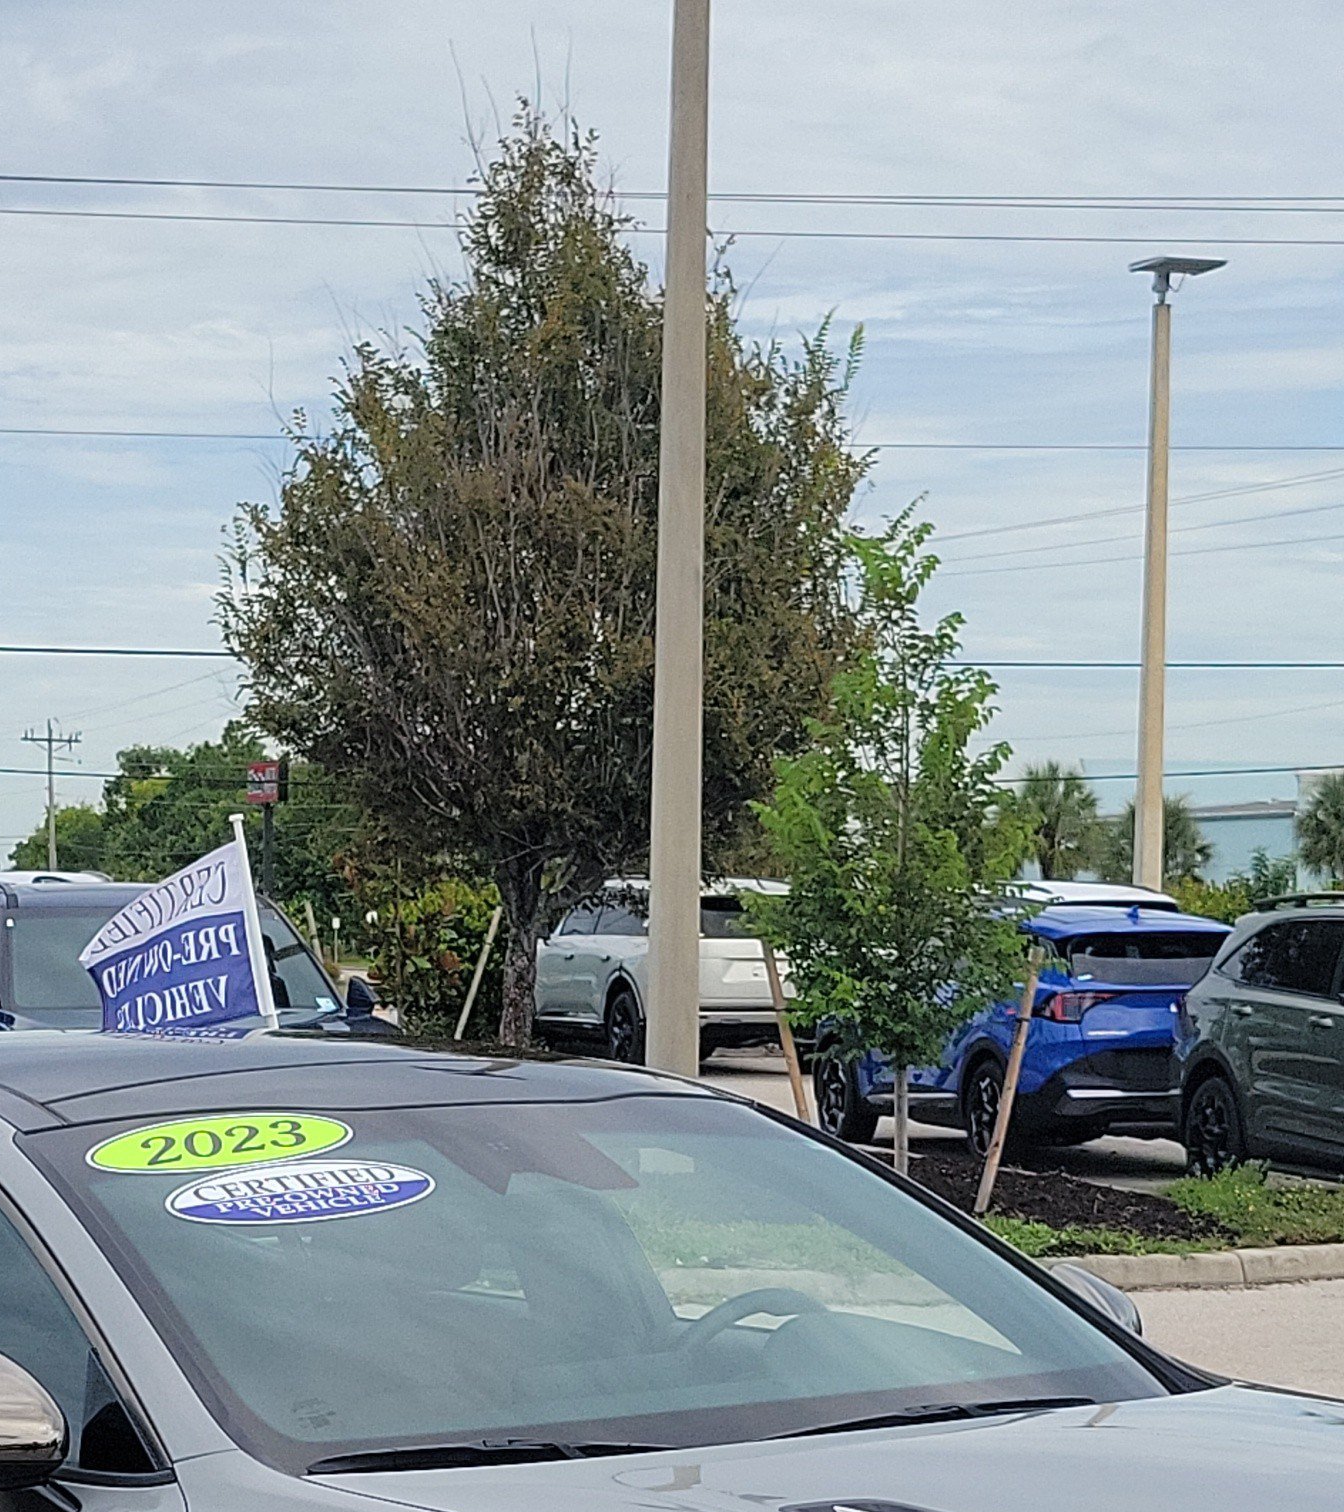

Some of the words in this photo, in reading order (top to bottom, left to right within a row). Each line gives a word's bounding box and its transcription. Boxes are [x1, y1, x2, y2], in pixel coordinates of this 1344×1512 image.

[140, 1119, 308, 1167] 2023
[193, 1166, 396, 1202] CERTIFIED
[214, 1182, 400, 1214] PRE-OWNED
[250, 1192, 386, 1218] VEHICLE
